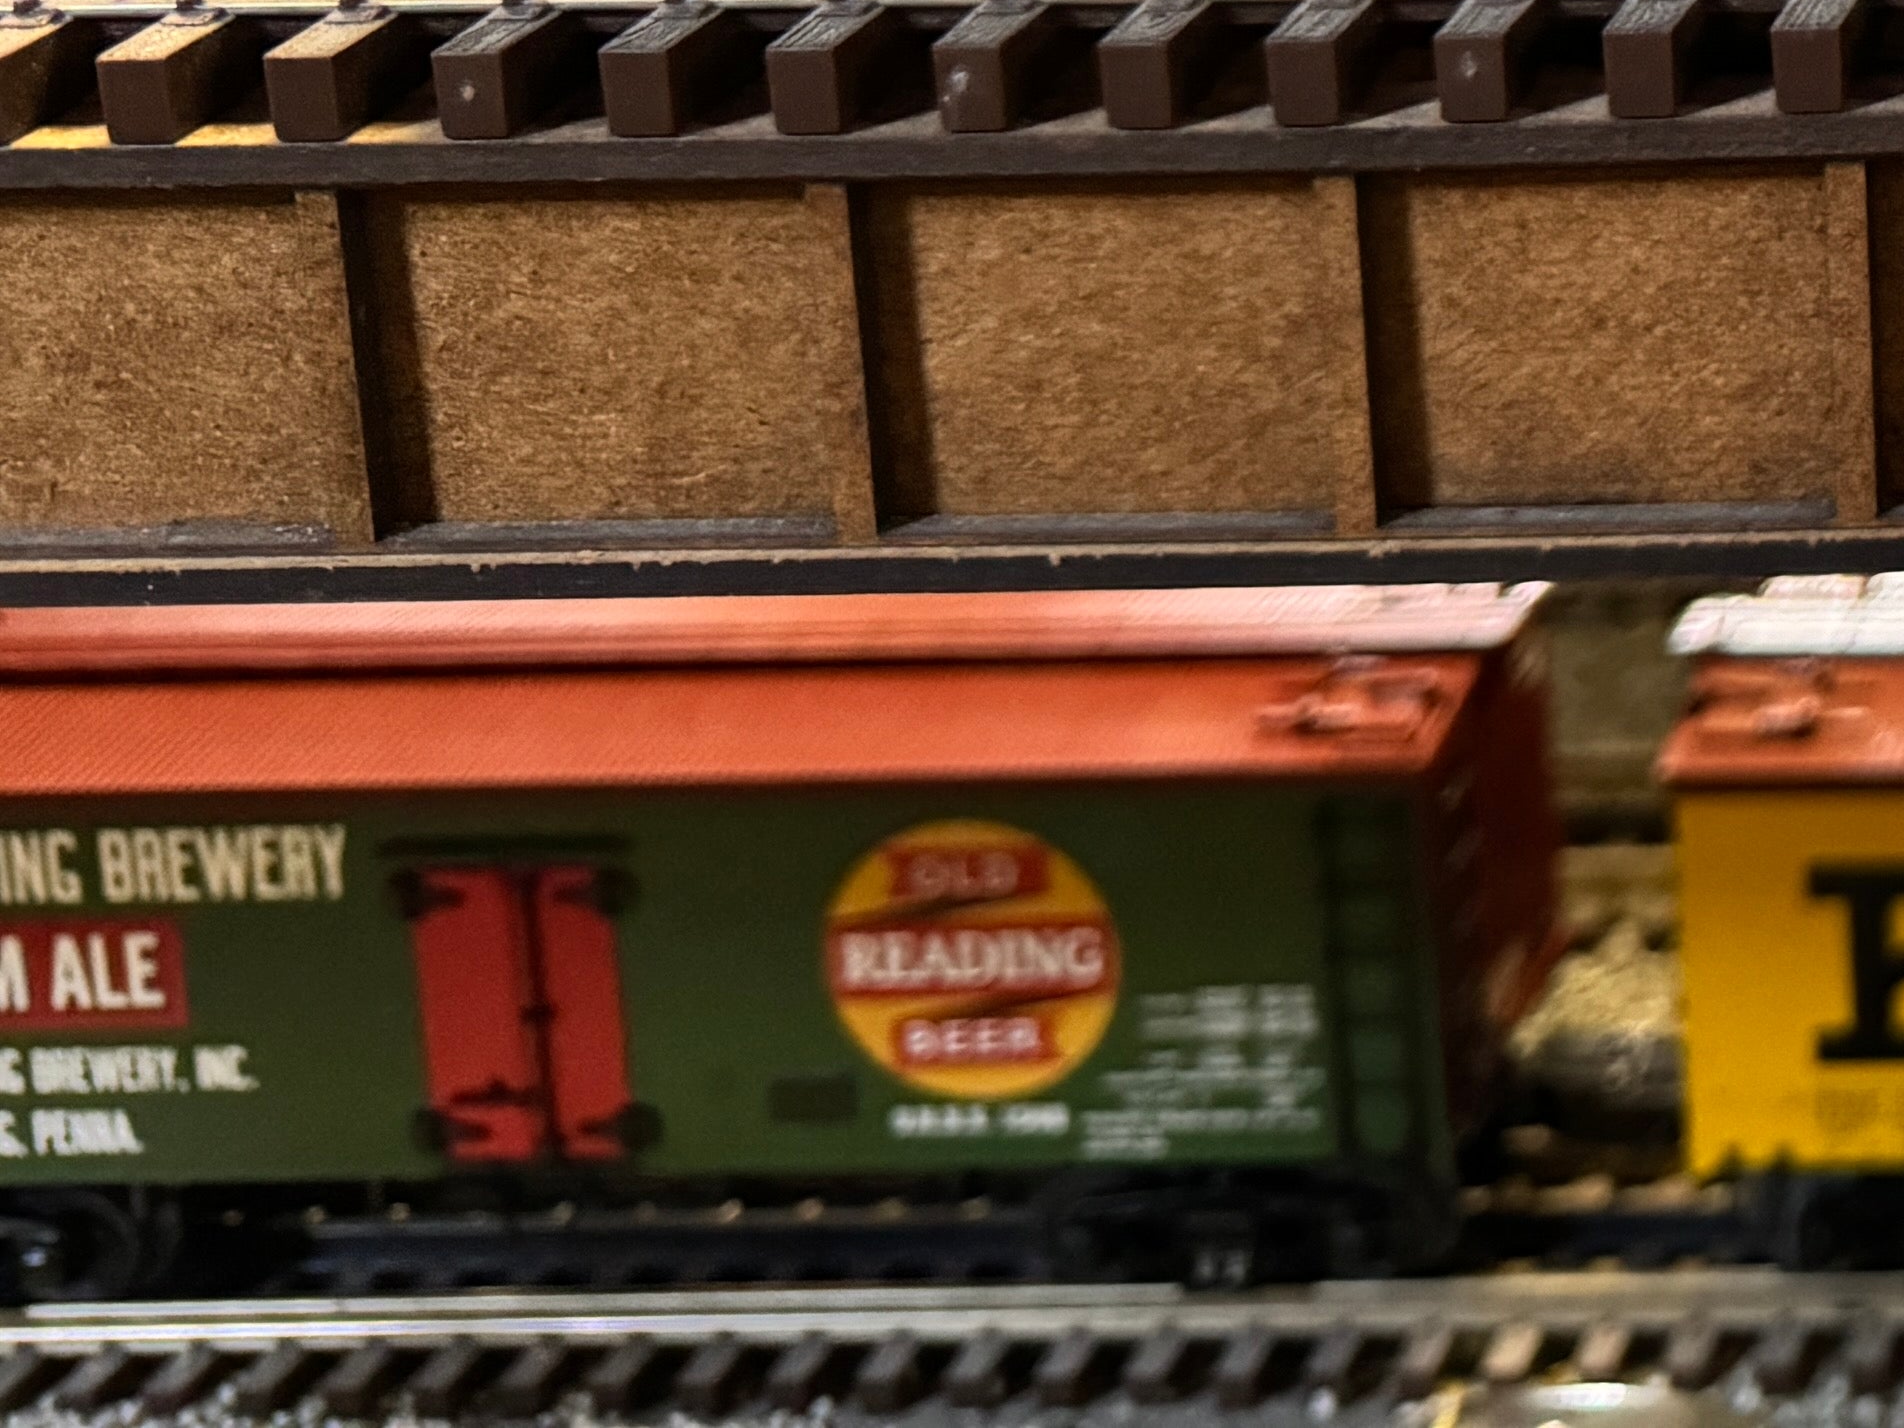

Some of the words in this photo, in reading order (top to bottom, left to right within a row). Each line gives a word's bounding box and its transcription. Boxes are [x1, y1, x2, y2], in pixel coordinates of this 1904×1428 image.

[96, 823, 347, 904] BREWERY
[906, 849, 1022, 899] OLD
[50, 929, 167, 1012] ALE
[838, 925, 1106, 992] READING
[903, 1016, 1041, 1061] BEER
